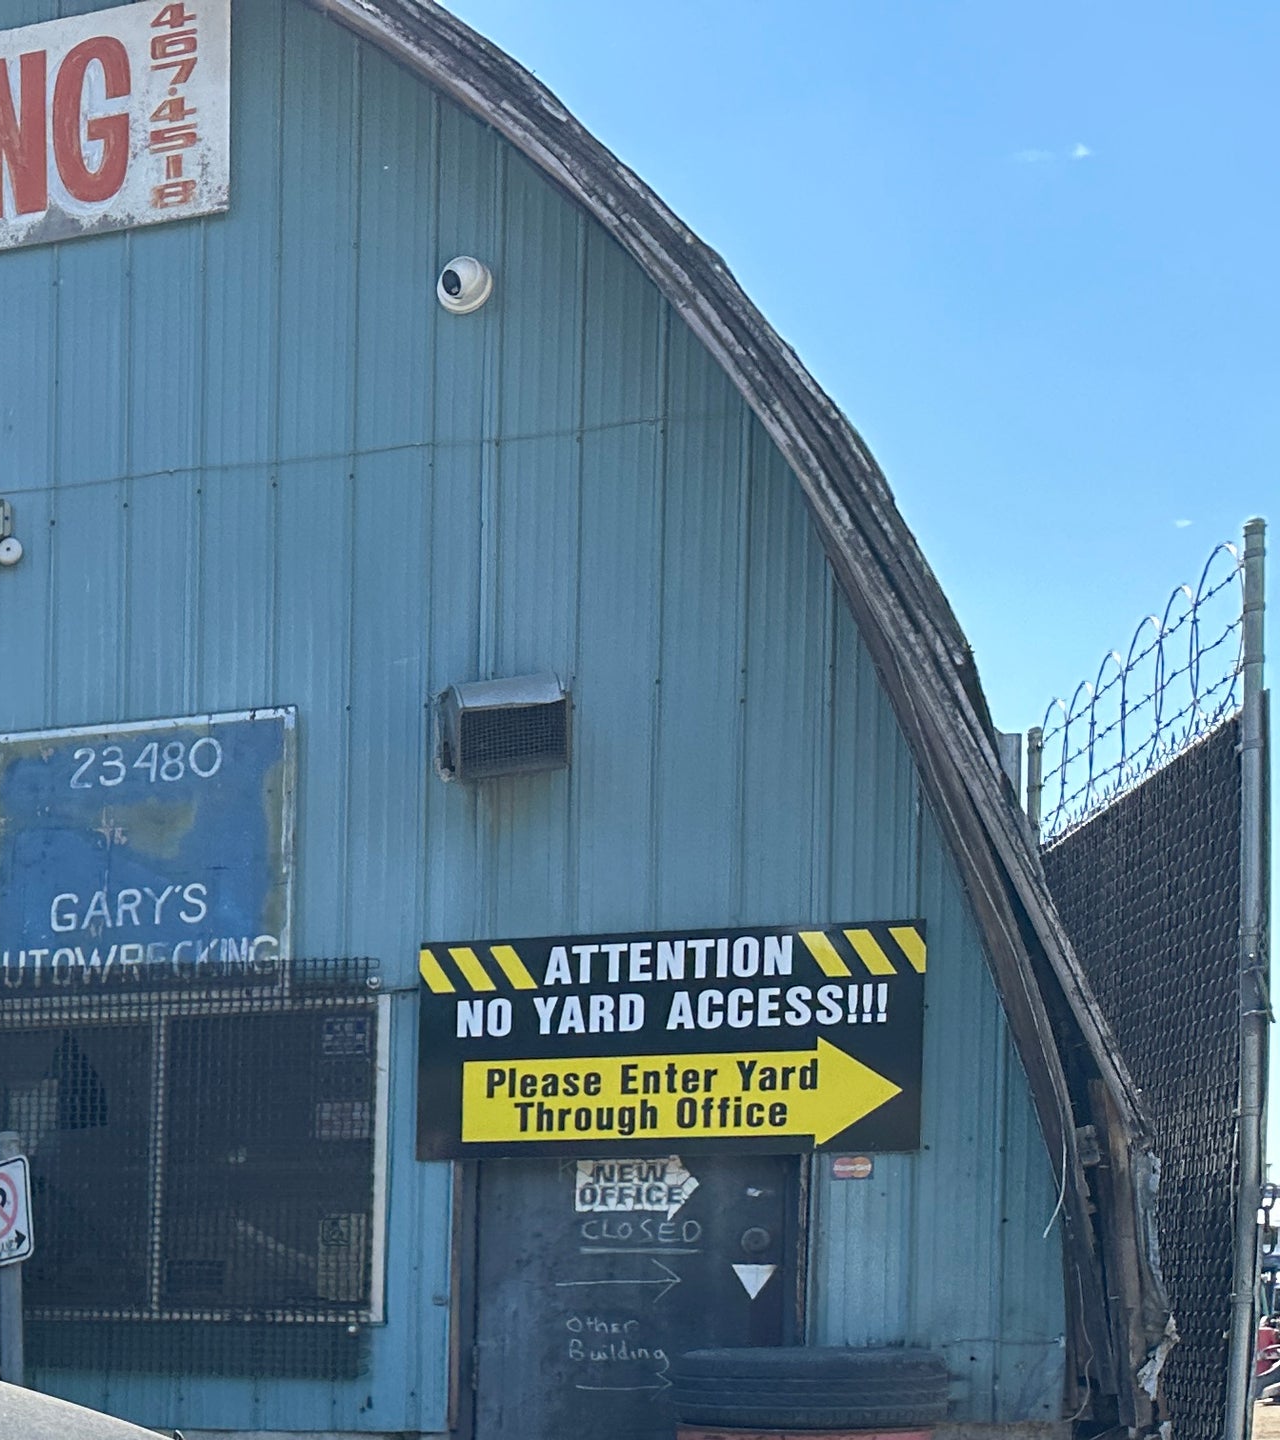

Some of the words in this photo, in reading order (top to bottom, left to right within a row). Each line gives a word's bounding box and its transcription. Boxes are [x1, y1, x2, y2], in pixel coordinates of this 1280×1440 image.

[70, 737, 223, 789] 23480
[51, 883, 207, 932] GARY'S
[544, 935, 793, 985] ATTENTION
[456, 999, 512, 1038] NO
[533, 993, 644, 1035] YARD
[666, 983, 888, 1030] ACCESS!!!
[486, 1068, 602, 1098] Please
[620, 1064, 718, 1095] Enter
[740, 1059, 819, 1090] Yard
[514, 1102, 658, 1136] Through
[676, 1097, 788, 1129] Office
[595, 1164, 668, 1184] NEW
[579, 1184, 684, 1205] OFFICE
[581, 1219, 702, 1243] CLOSED
[569, 1339, 671, 1369] Building
